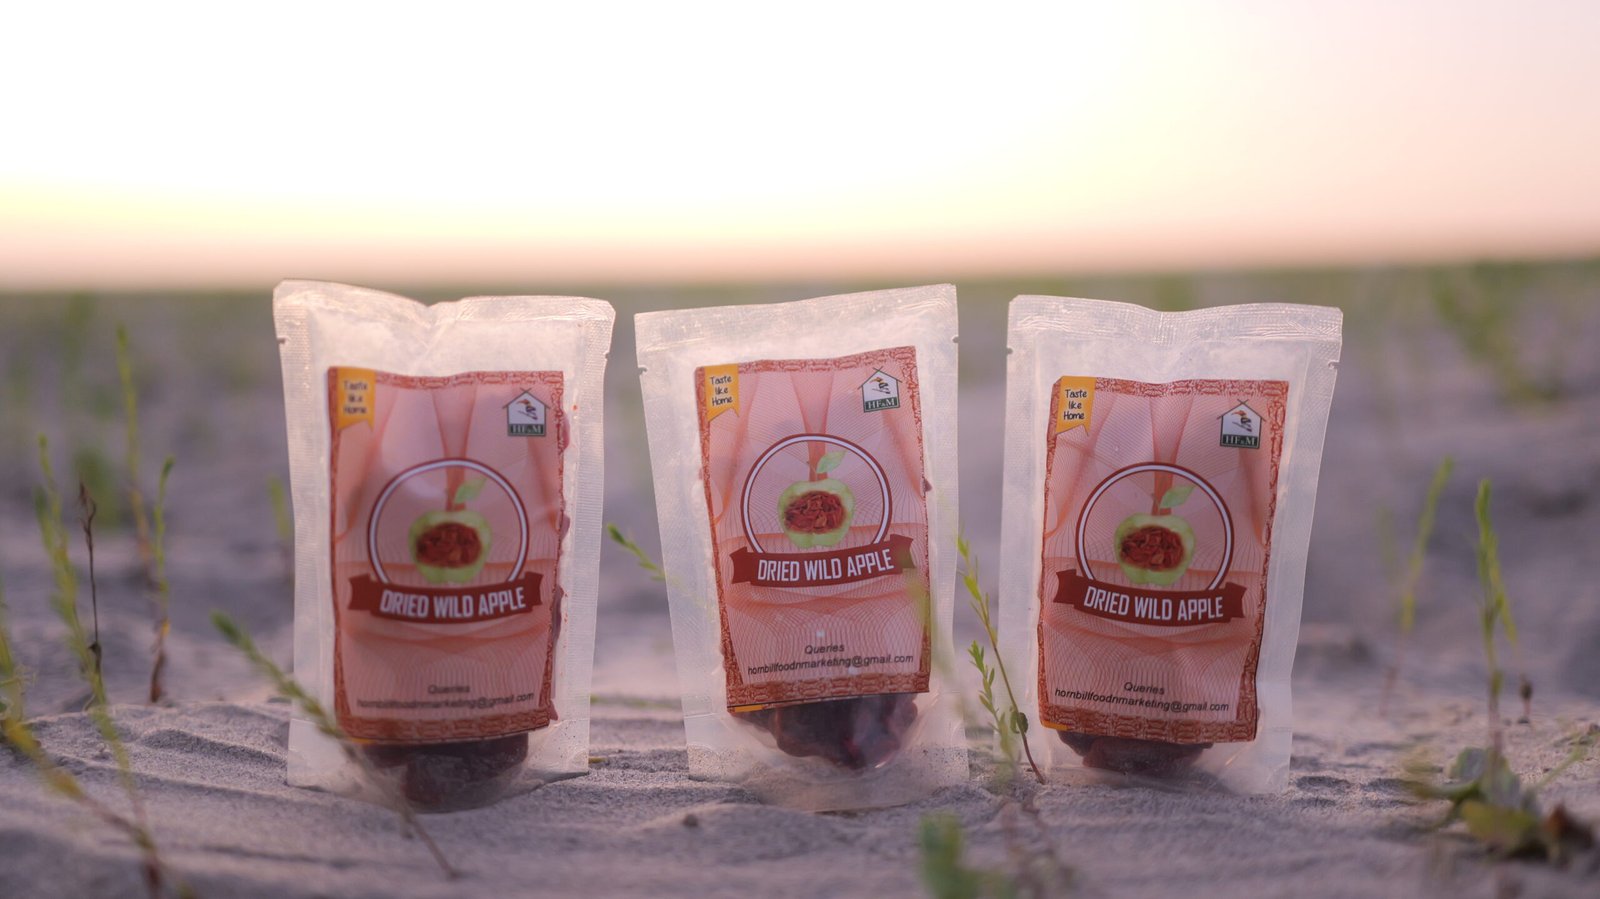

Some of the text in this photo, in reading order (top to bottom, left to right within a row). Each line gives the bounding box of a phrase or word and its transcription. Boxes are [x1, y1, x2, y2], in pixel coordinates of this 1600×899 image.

[709, 375, 732, 385] Taste
[714, 386, 729, 395] like
[1064, 388, 1088, 399] Taste
[711, 396, 734, 406] Home
[1068, 400, 1082, 410] like
[1063, 410, 1085, 420] Home
[757, 548, 895, 582] DRIED WILD APPLE
[379, 586, 527, 618] DRIED WILD APPLE
[1083, 585, 1224, 621] DRIED WILD APPLE
[804, 643, 845, 655] Queries
[1123, 681, 1166, 696] Queries
